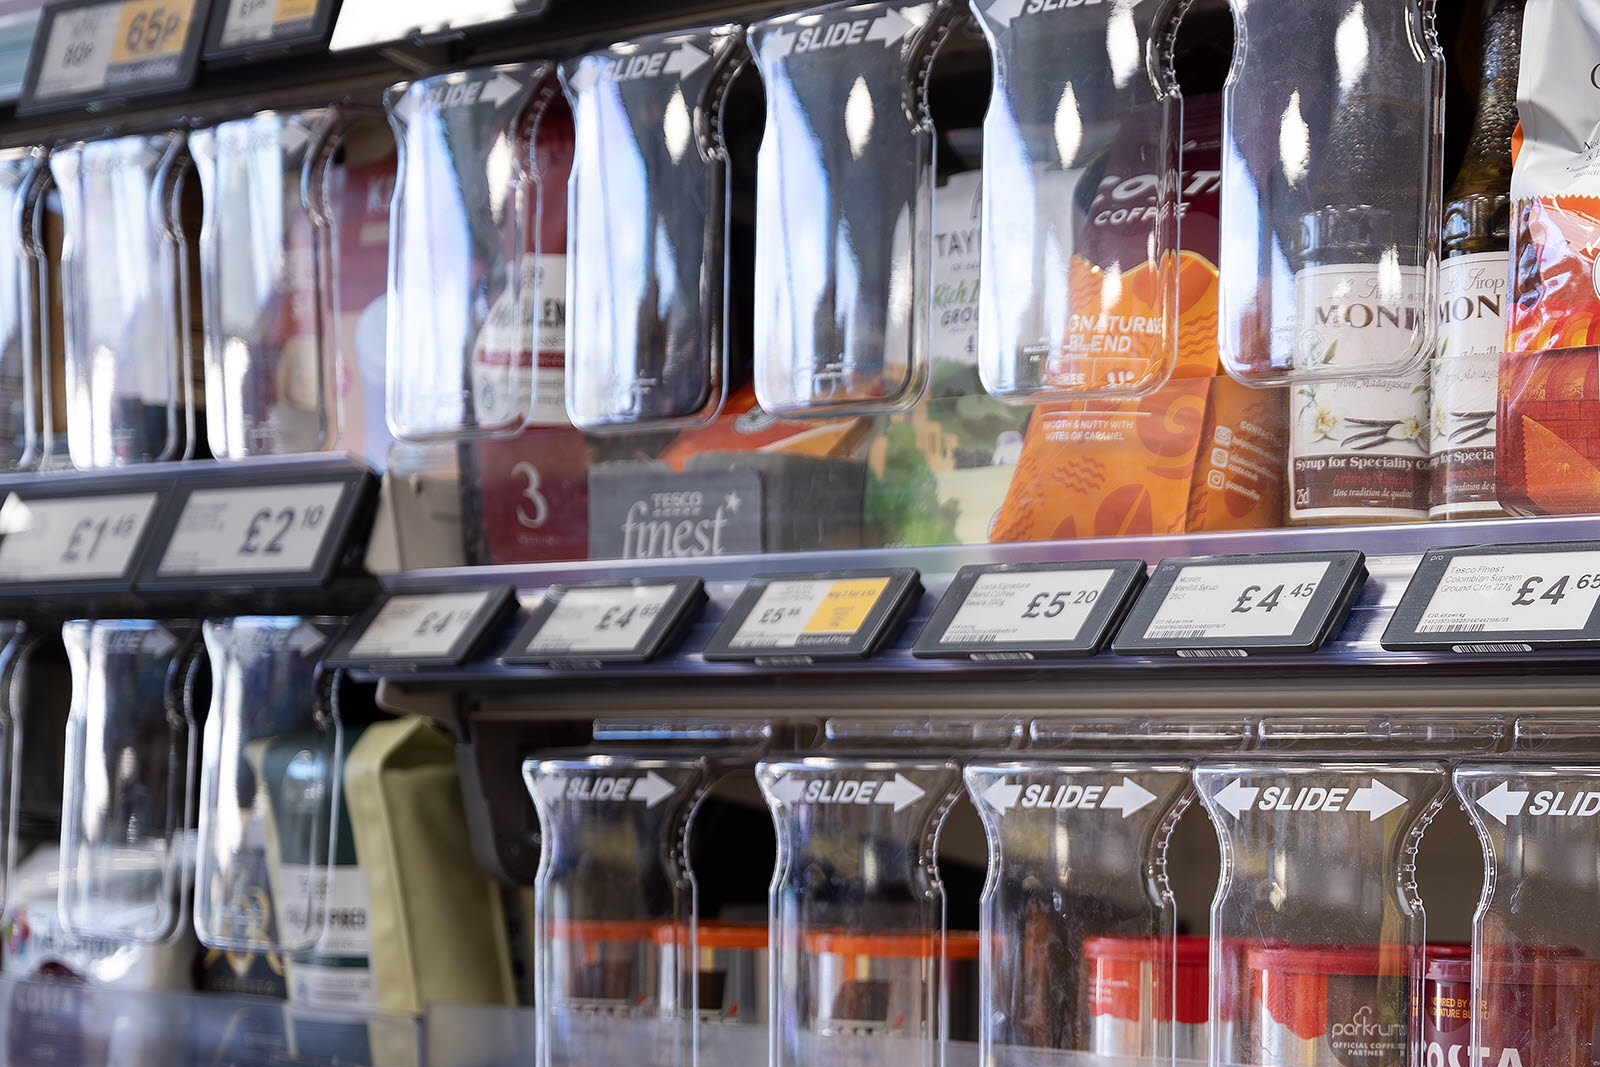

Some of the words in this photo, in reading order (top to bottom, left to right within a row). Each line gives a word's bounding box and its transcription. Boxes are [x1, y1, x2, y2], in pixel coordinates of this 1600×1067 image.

[795, 22, 865, 55] SLIDE
[603, 54, 666, 82] SLIDE
[1296, 458, 1325, 471] Syrup
[1327, 456, 1346, 468] for
[1350, 456, 1413, 471] Speciality
[511, 461, 548, 529] 3
[652, 492, 703, 507] TESCO
[622, 500, 728, 559] finest
[1180, 575, 1201, 583] Monin
[1445, 575, 1490, 584] Colombian
[1491, 574, 1523, 583] Suprem
[1450, 566, 1476, 574] Tesco
[1021, 589, 1098, 618] £5.20
[1230, 582, 1316, 613] £4.45
[564, 777, 633, 802] SLIDE
[802, 780, 879, 805] SLIDE
[1019, 784, 1103, 810] SLIDE
[1258, 786, 1346, 814] SLIDE
[1332, 1041, 1367, 1050] OFFICIAL
[1348, 1048, 1384, 1057] PARTNER
